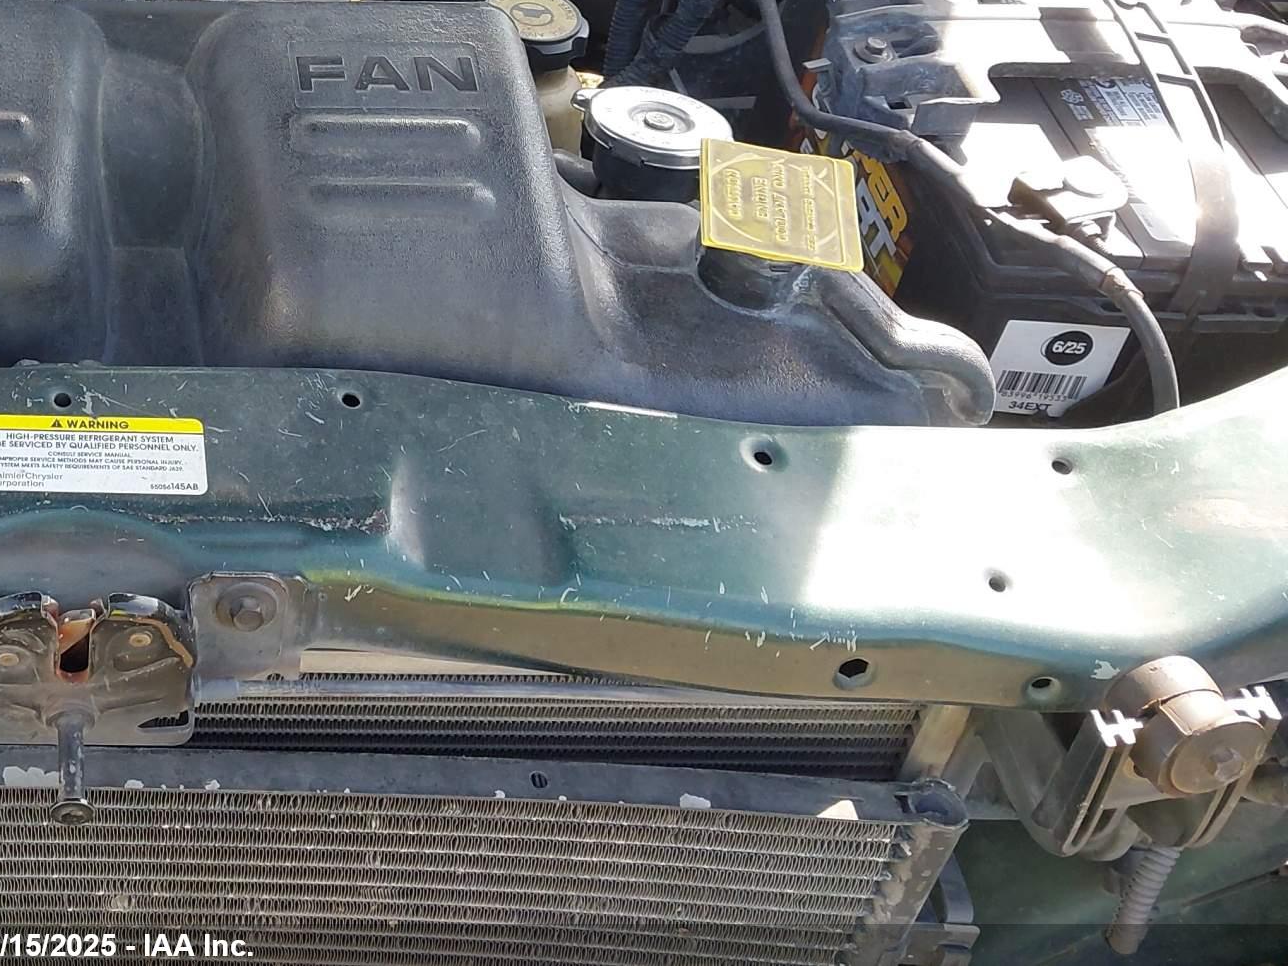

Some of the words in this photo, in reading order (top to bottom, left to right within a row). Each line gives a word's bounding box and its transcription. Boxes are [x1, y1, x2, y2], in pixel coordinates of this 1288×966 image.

[295, 55, 480, 92] FAN
[1052, 340, 1088, 355] 6/25
[1008, 400, 1053, 411] 34EXT
[67, 419, 129, 429] WARNING
[6, 433, 75, 441] HIGH-PRESSURE
[78, 434, 138, 442] REFRIGERANT
[141, 435, 173, 443] SYSTEM
[8, 440, 53, 448] SERVICED
[55, 441, 67, 449] BY
[69, 442, 116, 450] QUALIFIED
[118, 443, 170, 451] PERSONNEL
[172, 444, 199, 452] ONLY.
